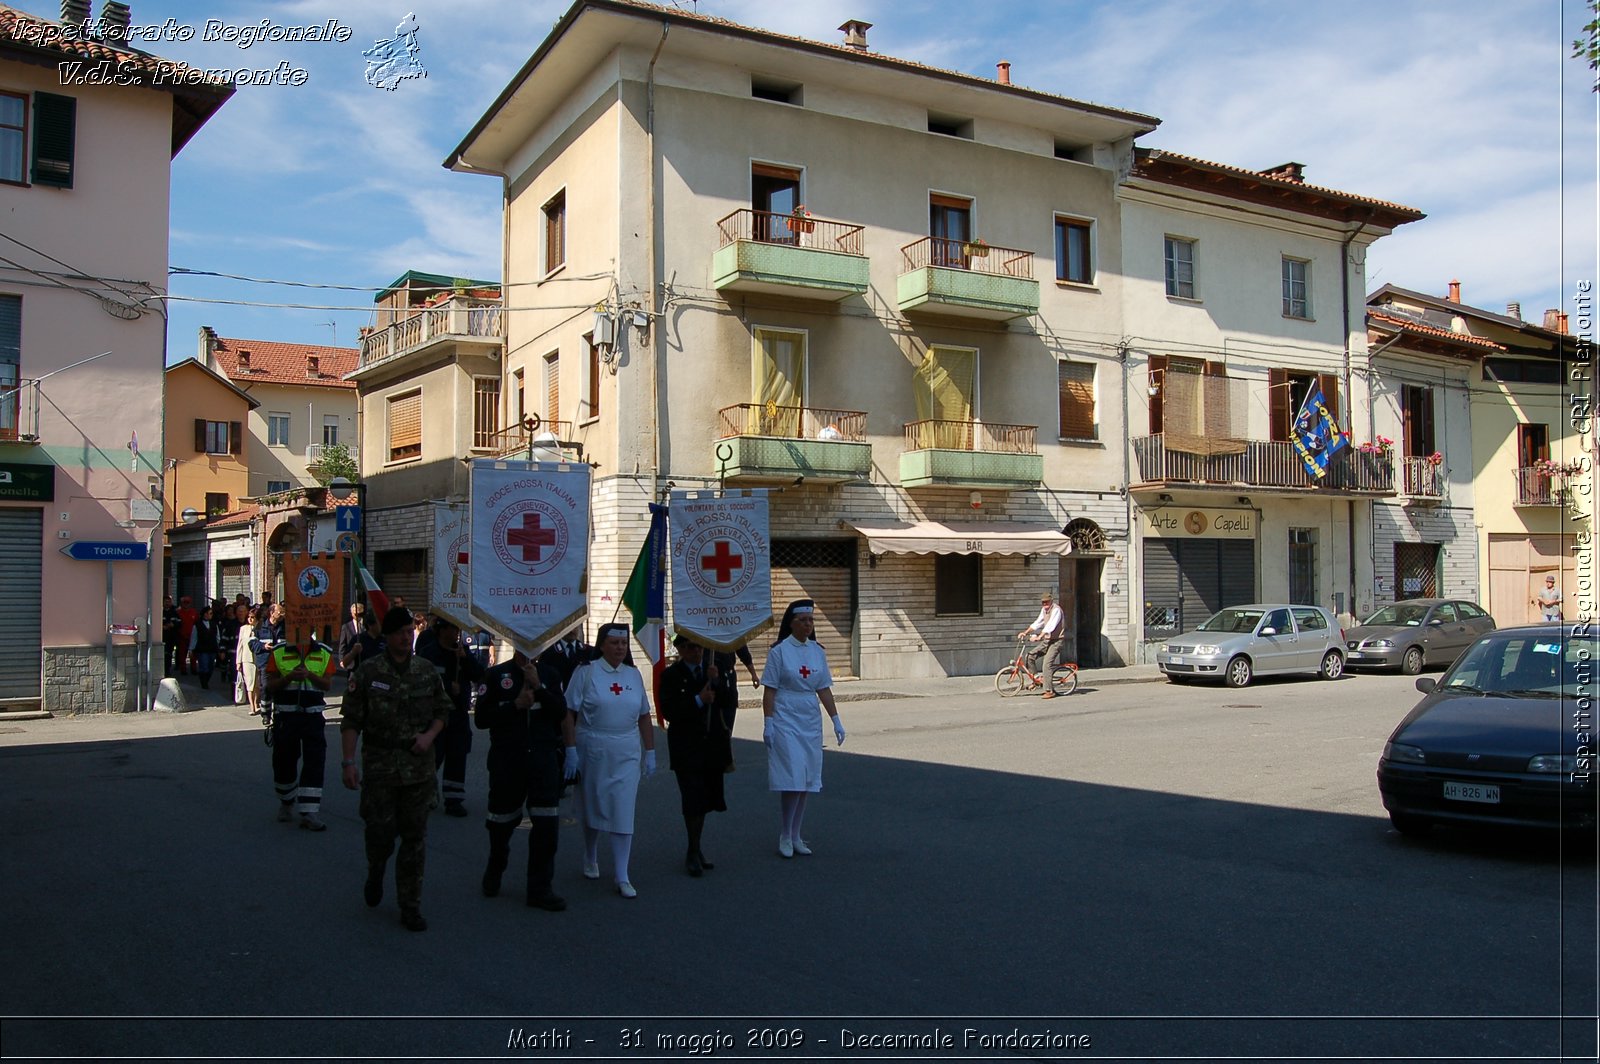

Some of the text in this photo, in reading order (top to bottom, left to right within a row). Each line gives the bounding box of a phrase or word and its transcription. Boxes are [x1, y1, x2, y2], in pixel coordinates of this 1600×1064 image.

[485, 479, 577, 510] CROCE ROSSA ITALIANA
[516, 501, 549, 512] GINEVRA
[1150, 512, 1178, 529] Arte
[1214, 514, 1250, 532] Capelli
[673, 512, 767, 558] CROCE ROSSA ITALIANA
[93, 547, 132, 555] TORINO
[966, 541, 983, 551] BAR
[687, 546, 717, 596] CONVENZIONE
[708, 527, 742, 541] GINEVRA
[743, 551, 754, 579] AGOSTO
[489, 587, 571, 596] DELEGAZIONE DI
[511, 604, 551, 614] MATHI
[686, 603, 759, 616] COMITATO LOCALE
[707, 616, 741, 627] FIANO
